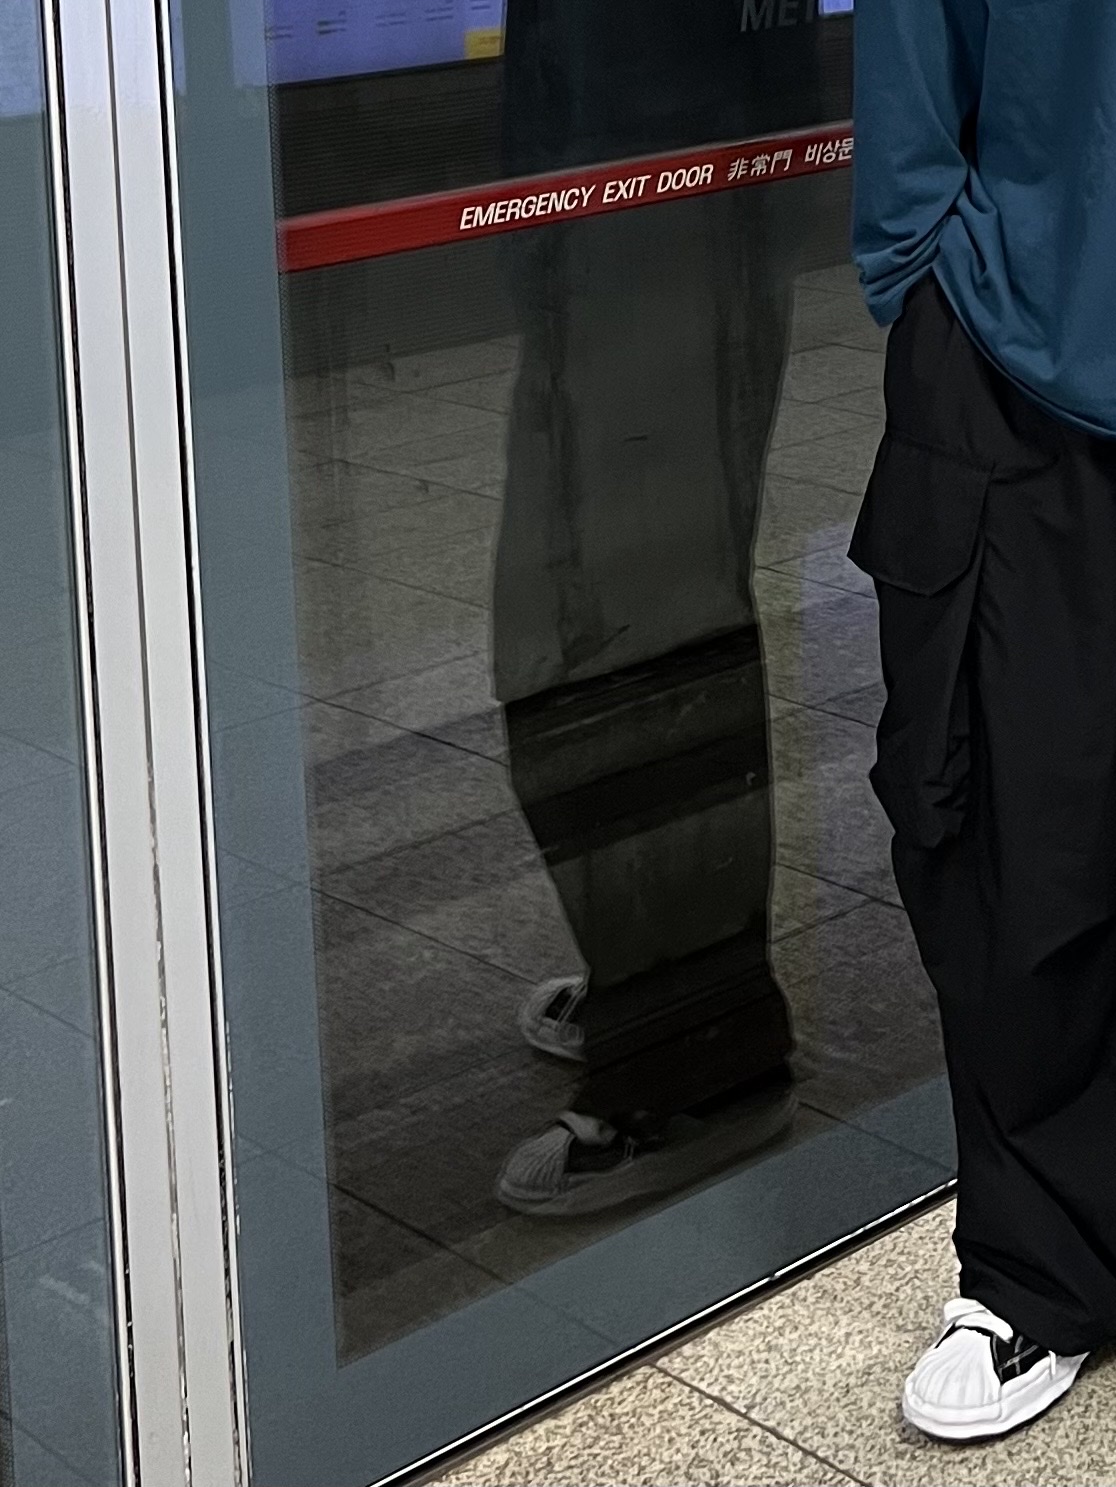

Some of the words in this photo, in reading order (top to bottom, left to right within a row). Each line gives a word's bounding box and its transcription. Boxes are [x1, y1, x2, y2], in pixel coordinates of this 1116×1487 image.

[727, 148, 793, 182] 非常門
[804, 137, 854, 167] 비상문
[459, 185, 595, 230] EMERGENCY
[602, 175, 651, 205] EXIT
[656, 164, 714, 194] DOOR
